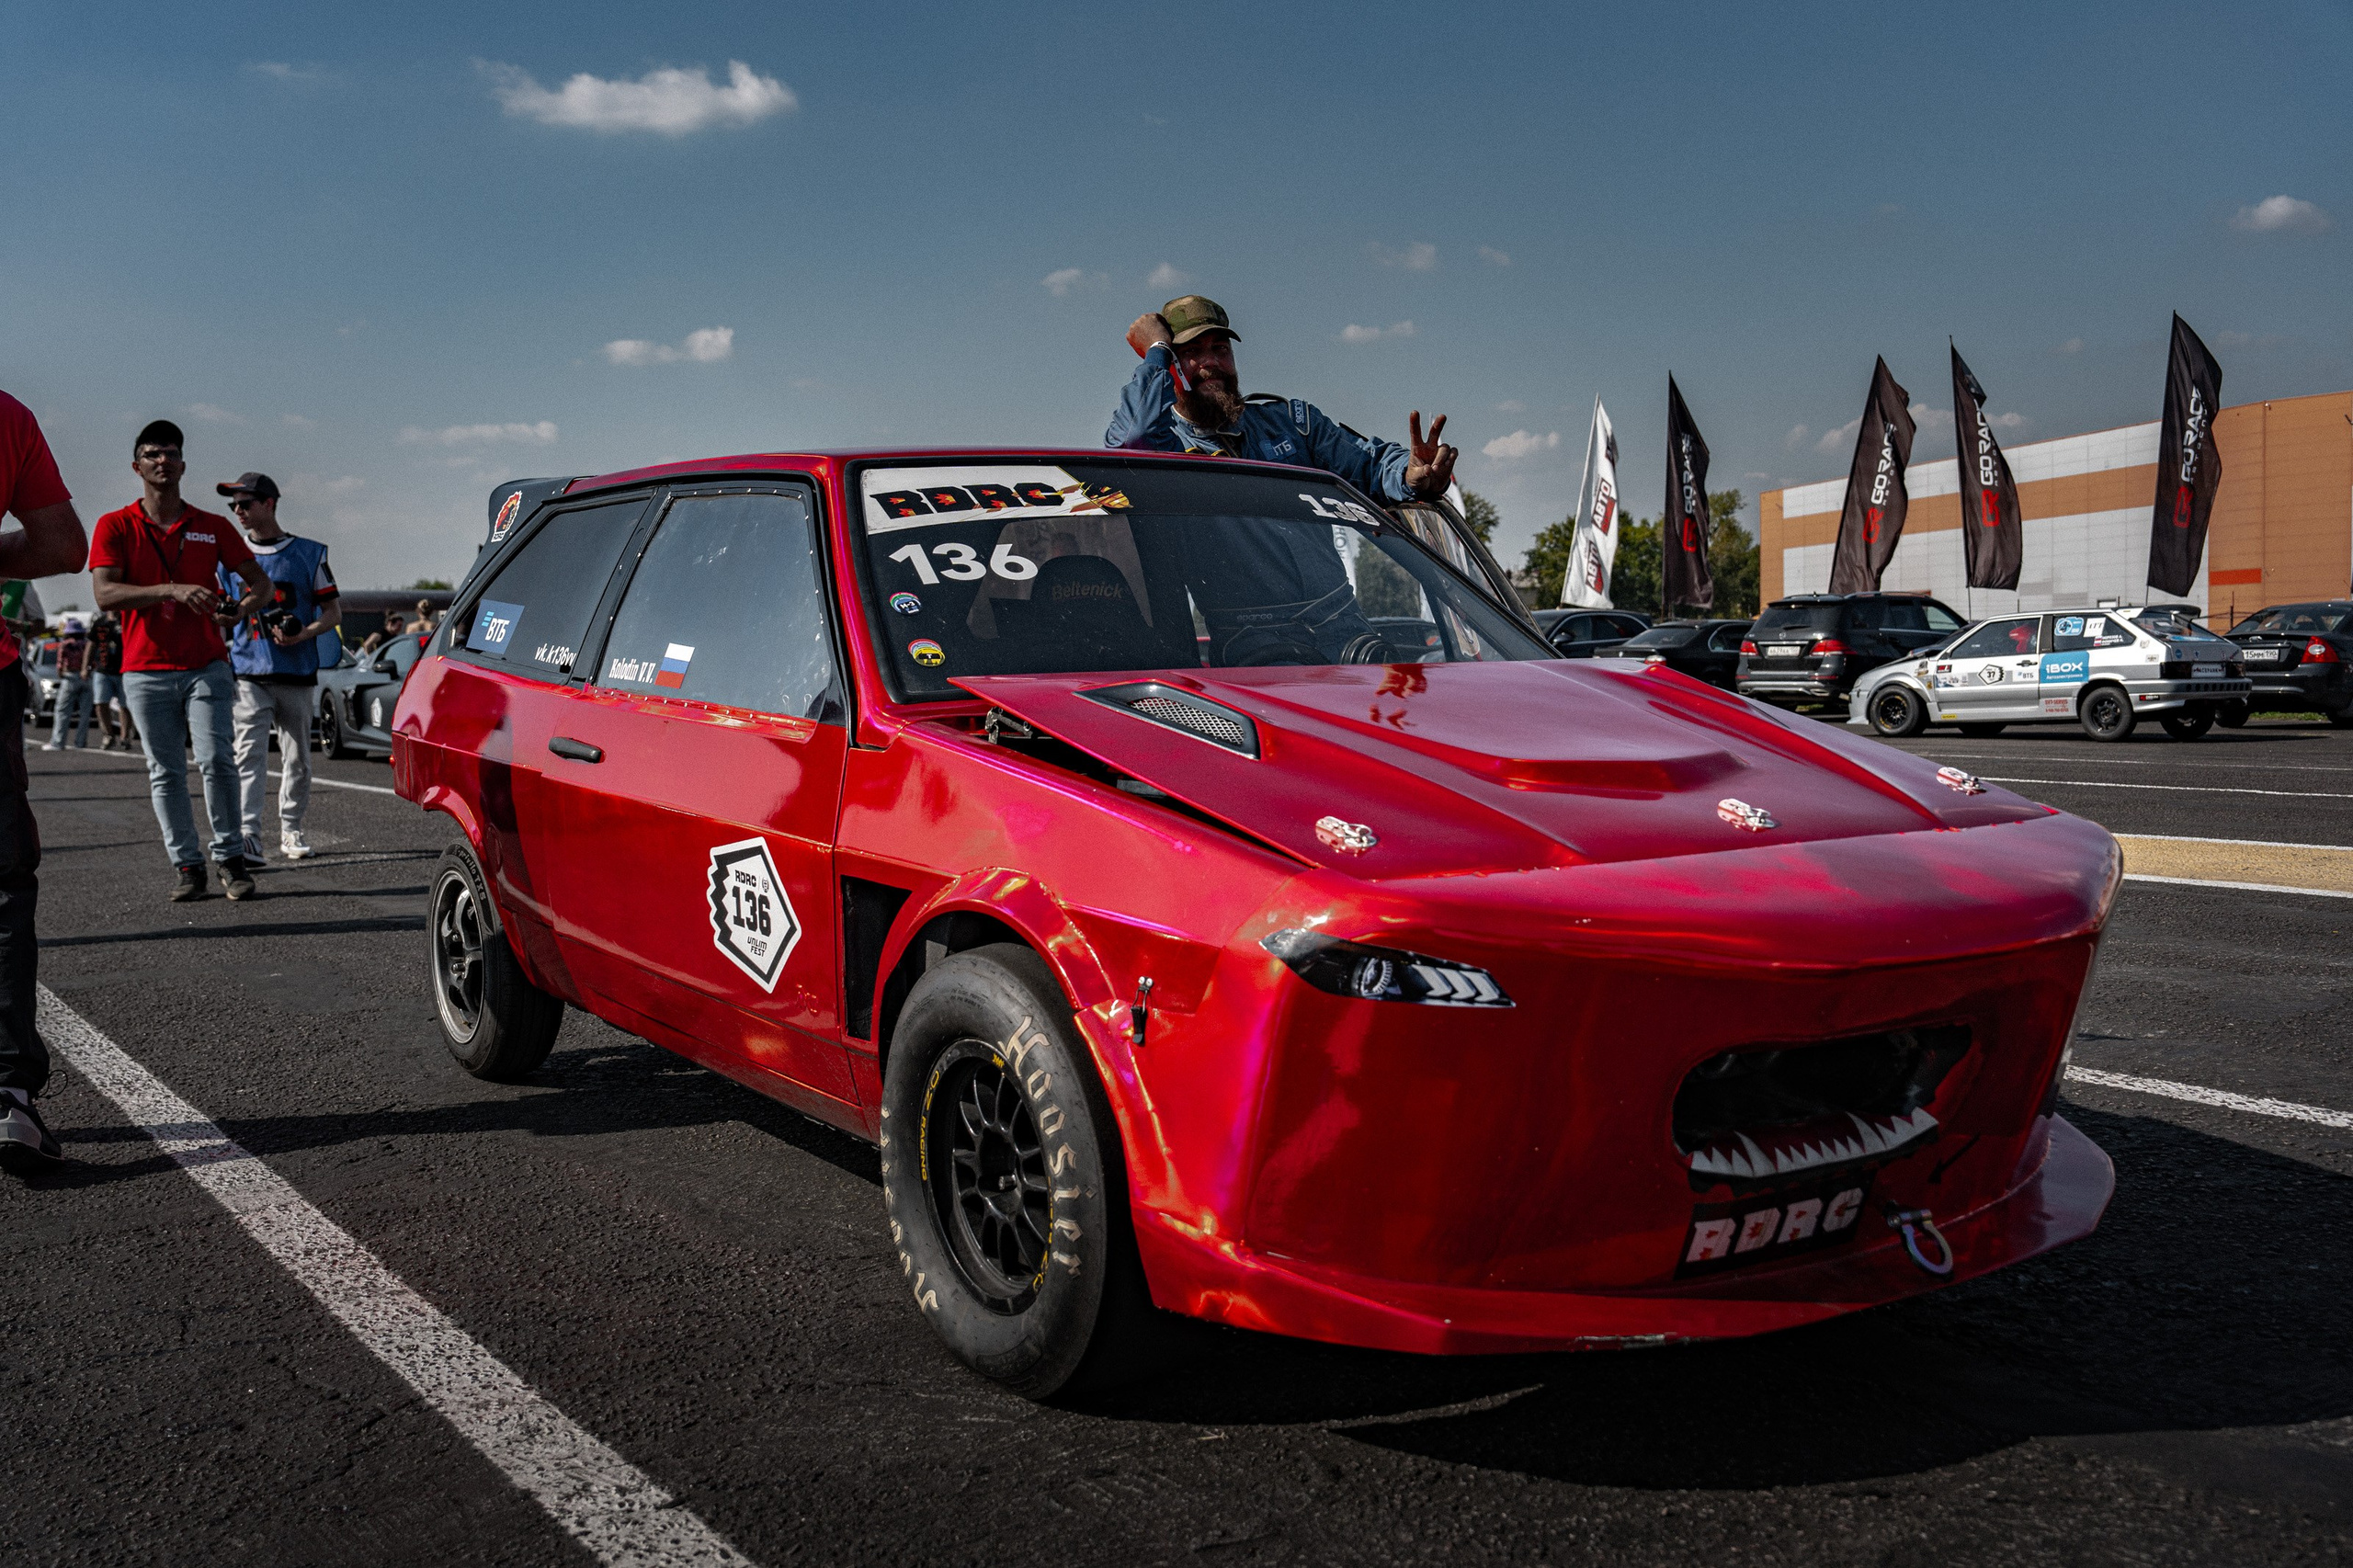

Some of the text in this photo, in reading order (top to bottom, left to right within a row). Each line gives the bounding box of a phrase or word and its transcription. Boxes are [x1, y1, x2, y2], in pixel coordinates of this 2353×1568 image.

[1298, 494, 1381, 527] 136
[889, 542, 1039, 585] 136
[484, 617, 510, 643] ВТБ
[608, 657, 640, 681] Kolodin
[734, 869, 756, 888] RDRC
[732, 885, 772, 937] 136
[750, 945, 766, 958] FEST
